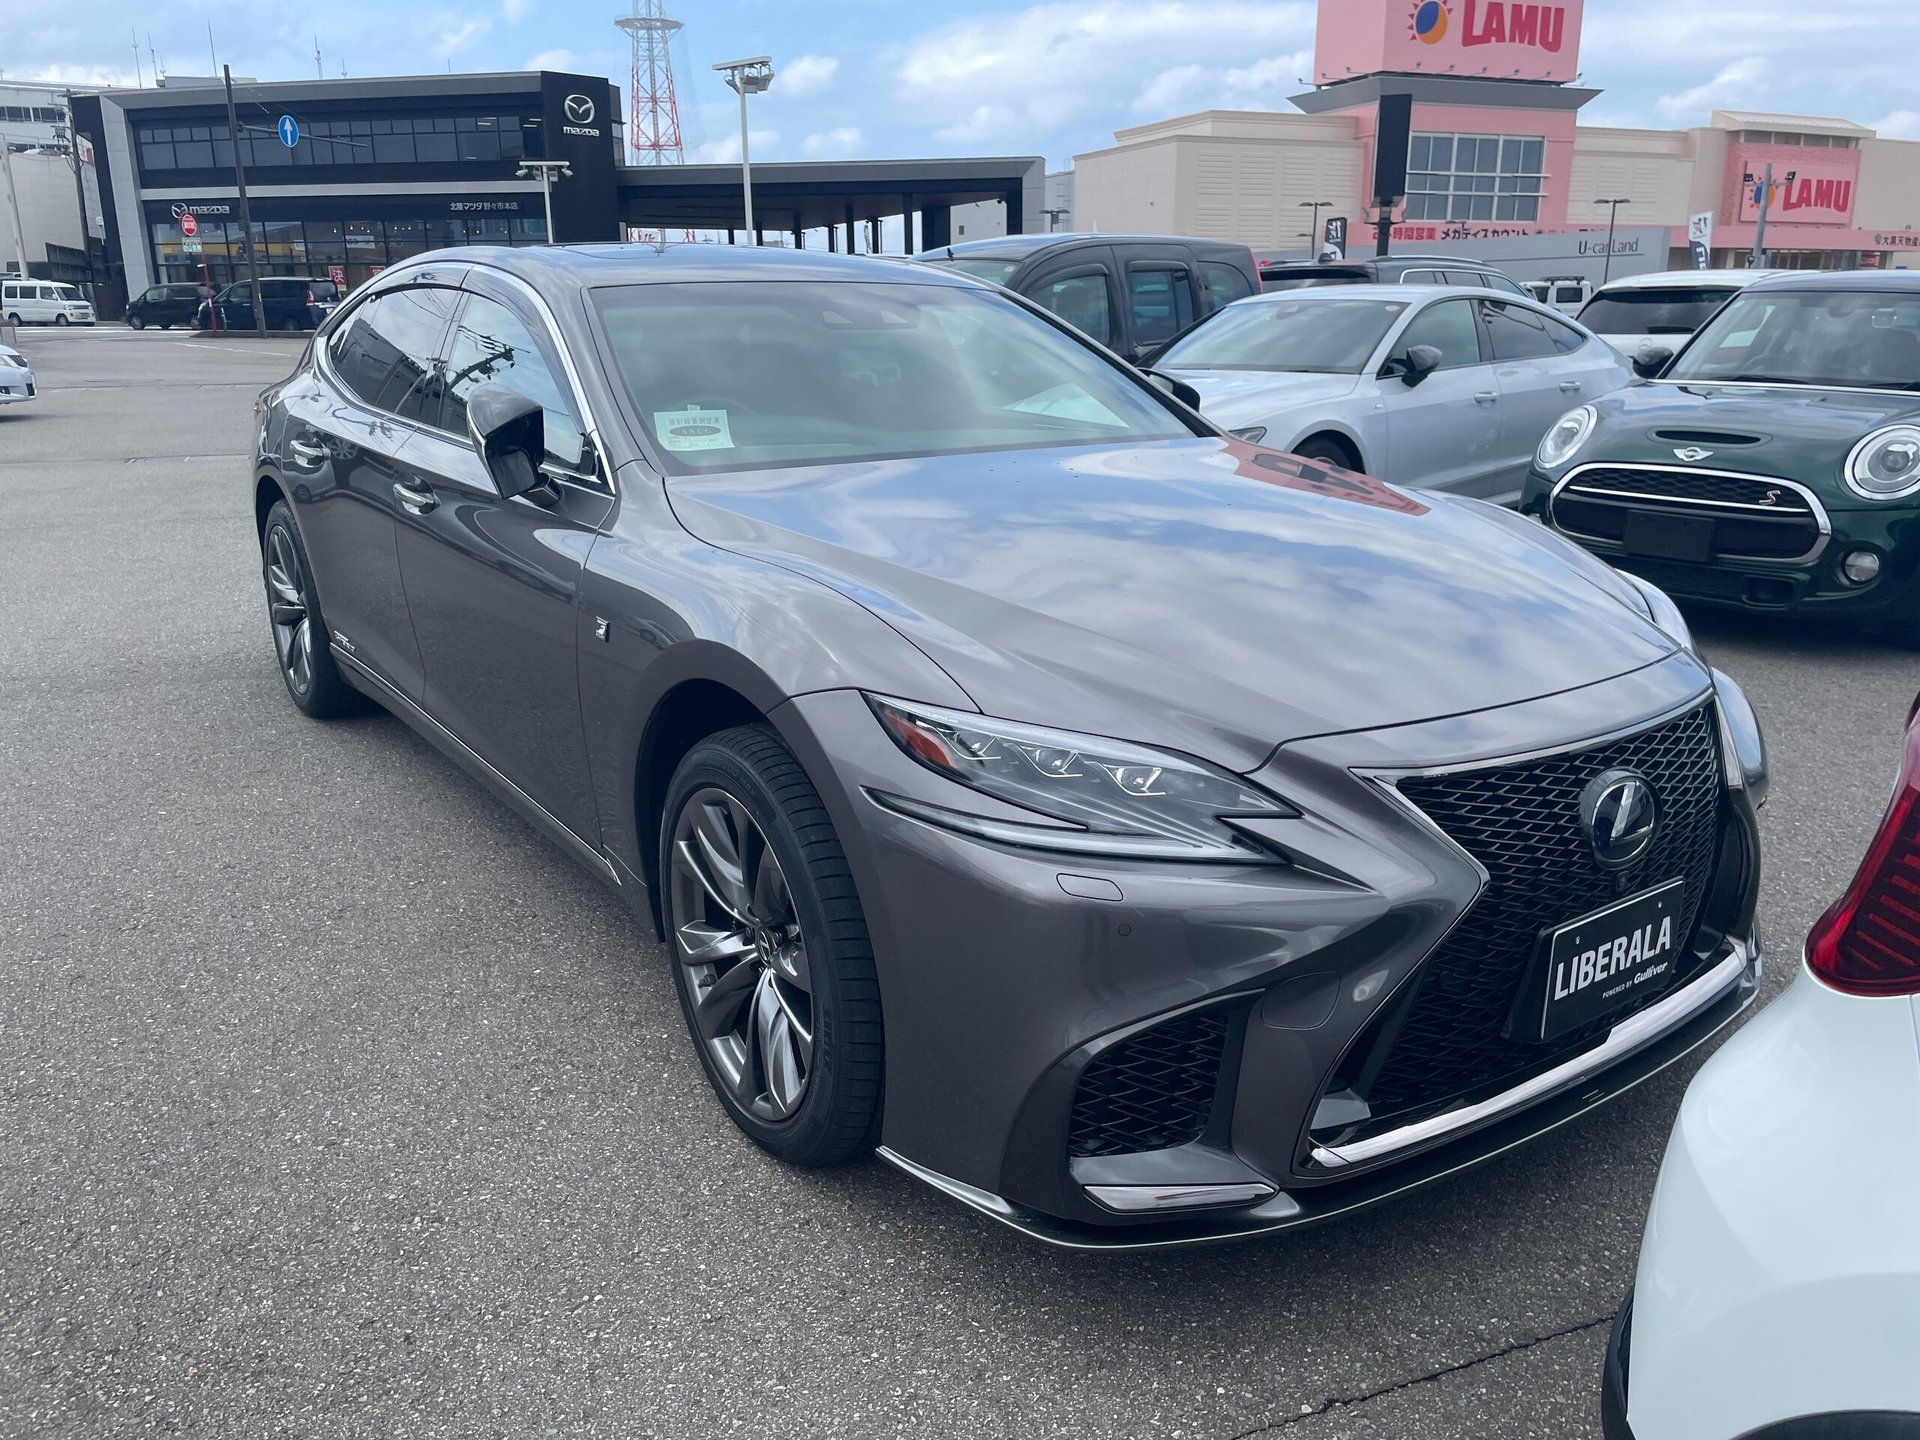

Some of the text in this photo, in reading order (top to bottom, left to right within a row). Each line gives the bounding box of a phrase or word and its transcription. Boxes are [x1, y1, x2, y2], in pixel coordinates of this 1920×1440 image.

[1462, 0, 1564, 53] LAMU
[563, 126, 599, 137] mazda
[189, 205, 230, 214] mazda
[1782, 178, 1851, 213] LAMU
[1554, 915, 1671, 1001] LIBERALA
[1602, 961, 1668, 999] POWERED BY Gulliver
